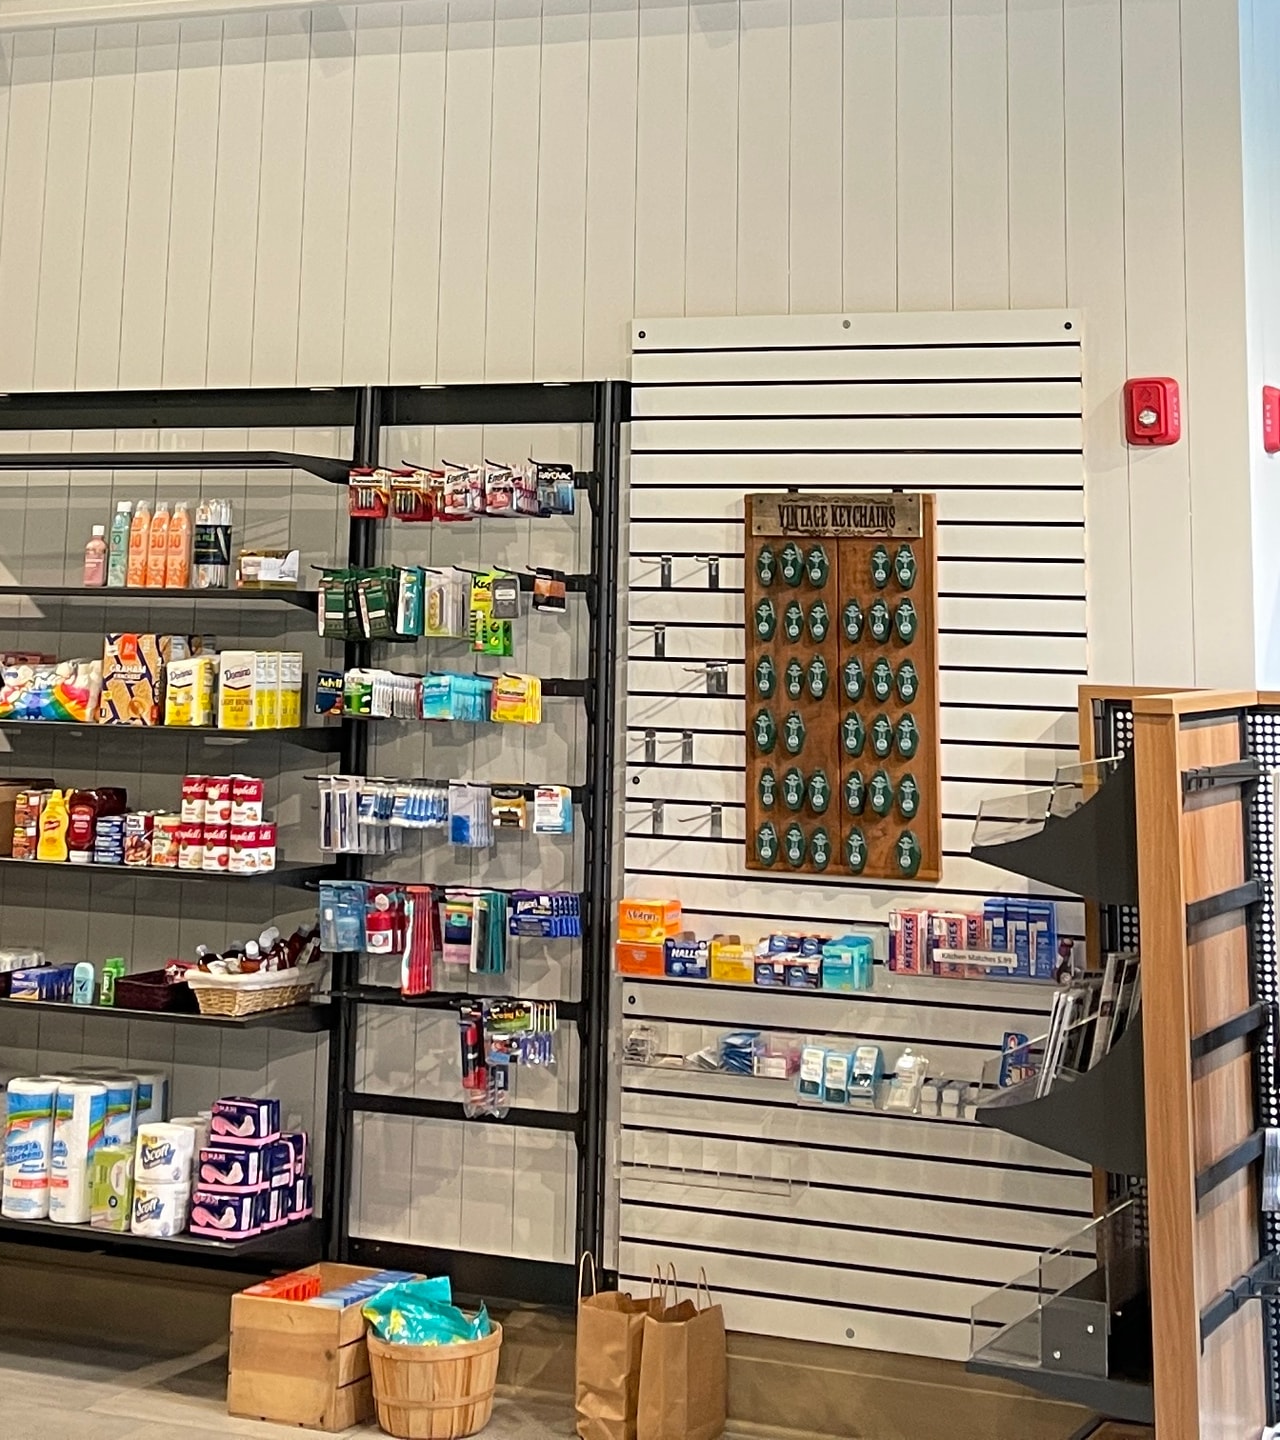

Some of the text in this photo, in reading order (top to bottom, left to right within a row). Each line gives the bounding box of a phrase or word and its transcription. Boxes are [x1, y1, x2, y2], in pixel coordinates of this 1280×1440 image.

[777, 504, 896, 528] VINTAGE KEYCHAINS
[224, 668, 252, 681] Domino
[904, 917, 914, 969] MATCHES
[941, 953, 967, 961] Kitchen
[968, 954, 996, 963] Matches
[144, 1143, 170, 1161] Scott
[136, 1197, 160, 1214] Scott
